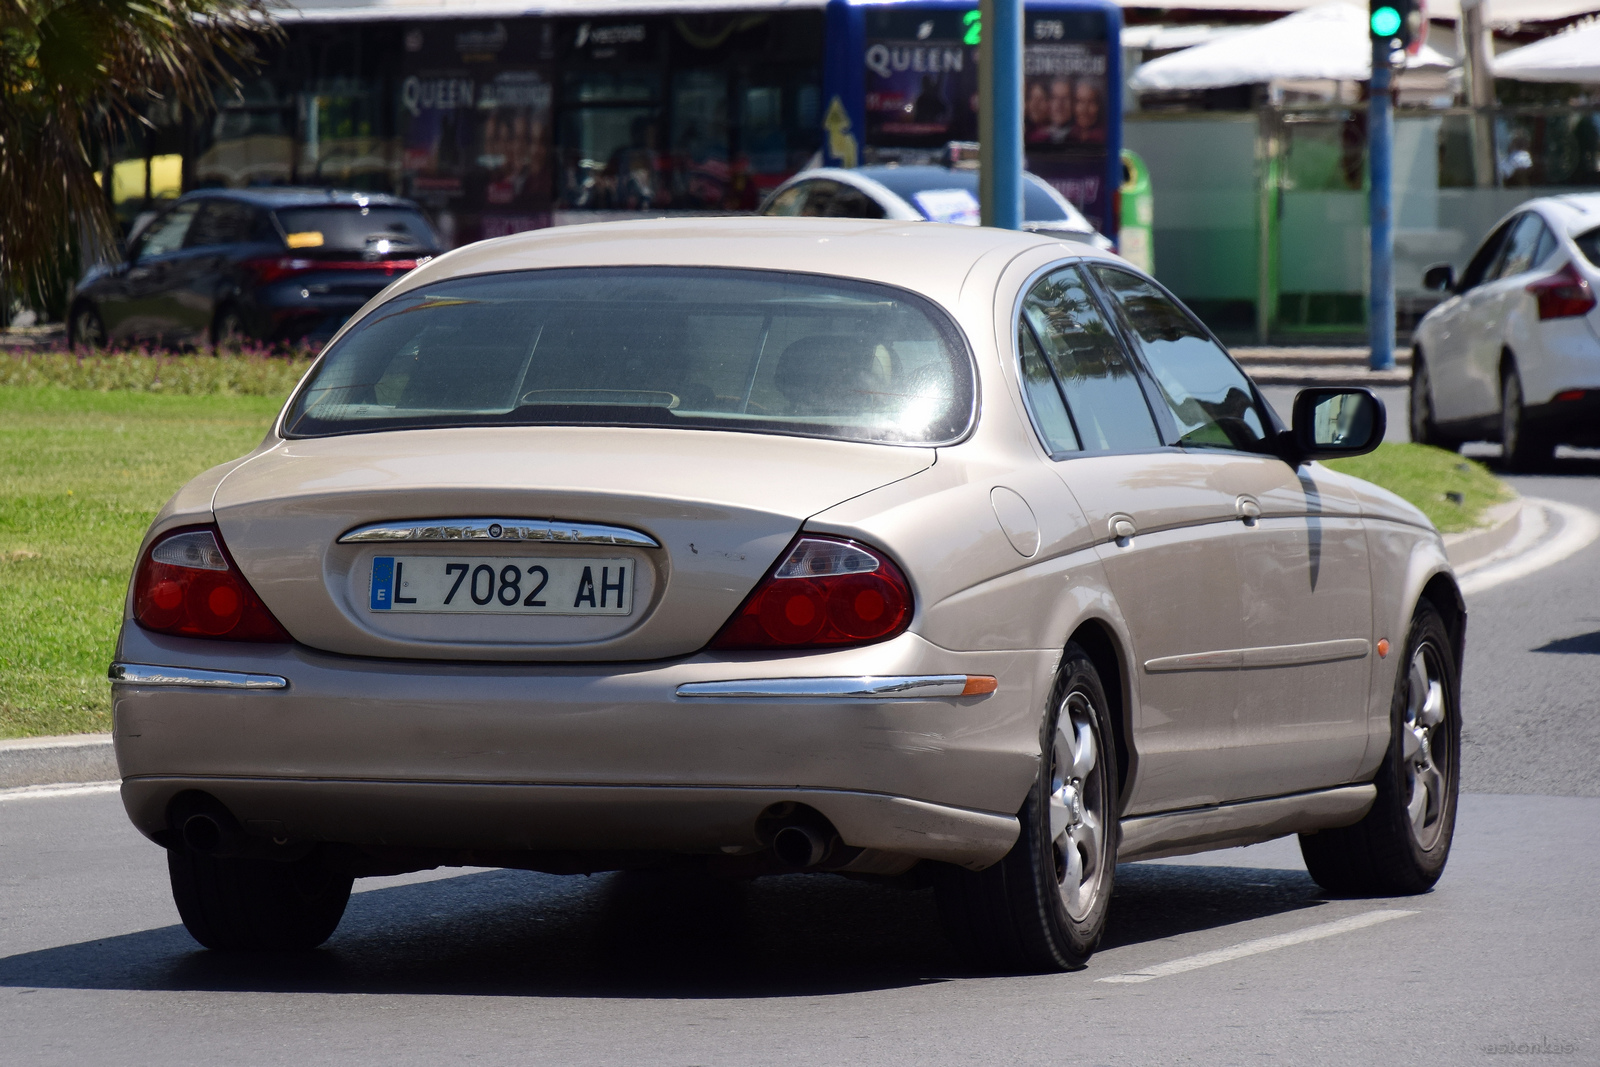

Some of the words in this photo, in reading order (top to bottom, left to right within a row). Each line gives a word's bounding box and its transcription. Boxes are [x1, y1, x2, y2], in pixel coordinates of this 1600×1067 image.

[866, 44, 963, 78] QUEEN
[403, 76, 474, 116] QUEEN
[377, 589, 386, 601] E
[394, 562, 417, 604] L
[443, 563, 549, 607] 7082
[573, 566, 626, 609] AH
